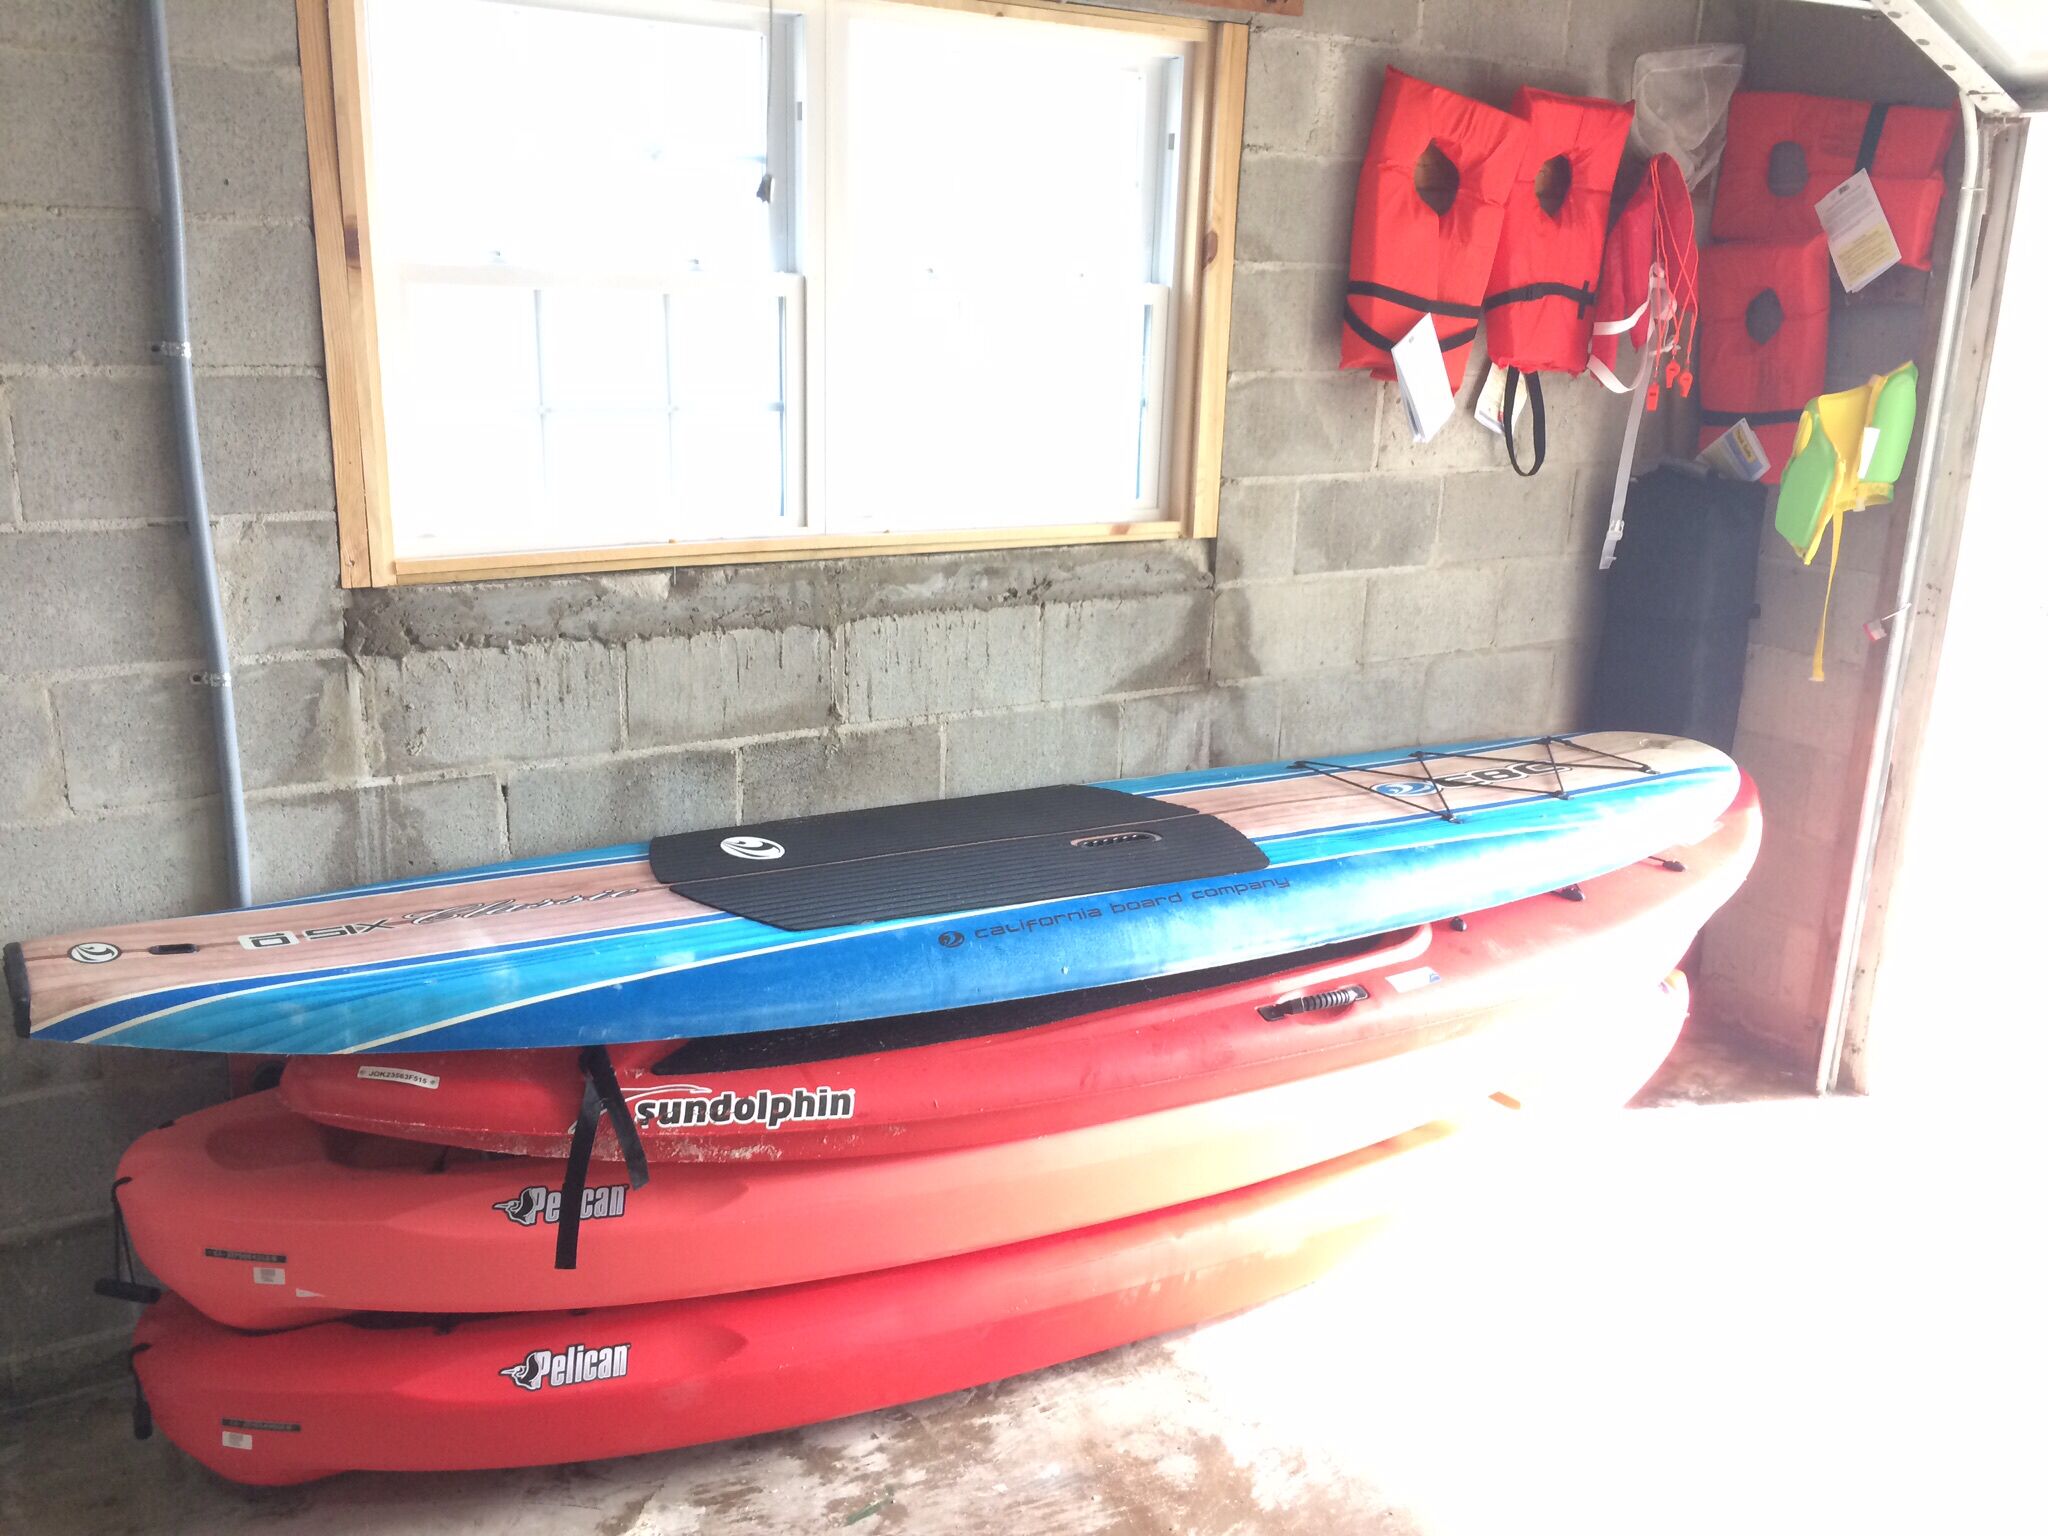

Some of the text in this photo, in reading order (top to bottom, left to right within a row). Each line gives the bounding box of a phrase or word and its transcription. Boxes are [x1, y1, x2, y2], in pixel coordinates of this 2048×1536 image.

[402, 888, 640, 925] Classic
[974, 876, 1291, 940] california board company
[634, 1085, 855, 1130] sundolphin
[526, 1184, 628, 1224] Pecan
[530, 1345, 631, 1390] Pelican
